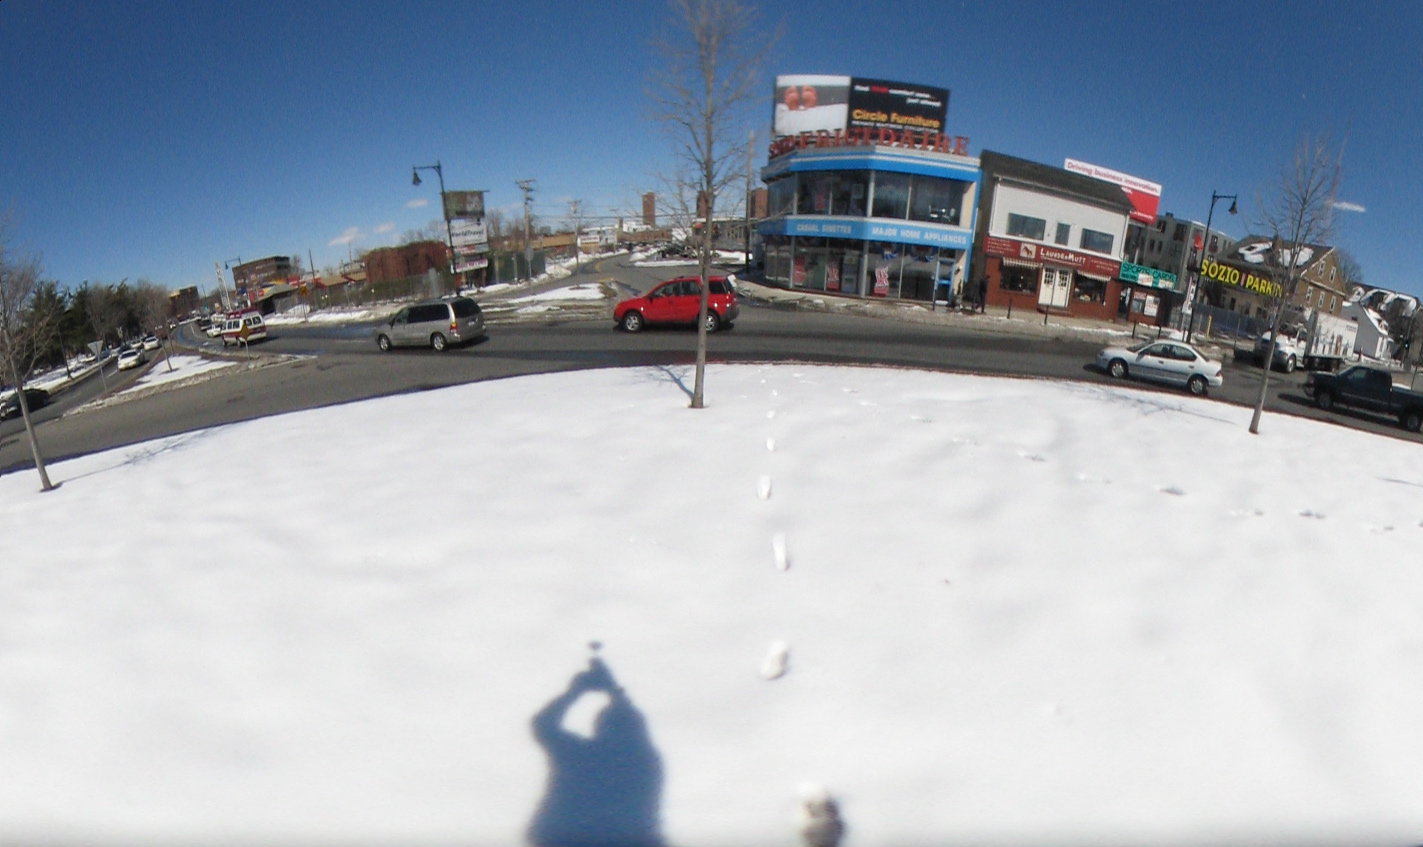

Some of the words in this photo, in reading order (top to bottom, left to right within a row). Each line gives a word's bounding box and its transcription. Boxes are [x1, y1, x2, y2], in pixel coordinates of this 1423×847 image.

[852, 109, 888, 122] Circle
[890, 112, 940, 128] Furniture
[1067, 161, 1093, 177] Driving
[1094, 168, 1123, 182] business
[871, 226, 897, 237] MAJOR
[900, 228, 921, 240] HOME
[923, 230, 967, 245] APPLIANCES
[1200, 258, 1240, 285] SOZIO
[1245, 273, 1283, 298] PARKIN
